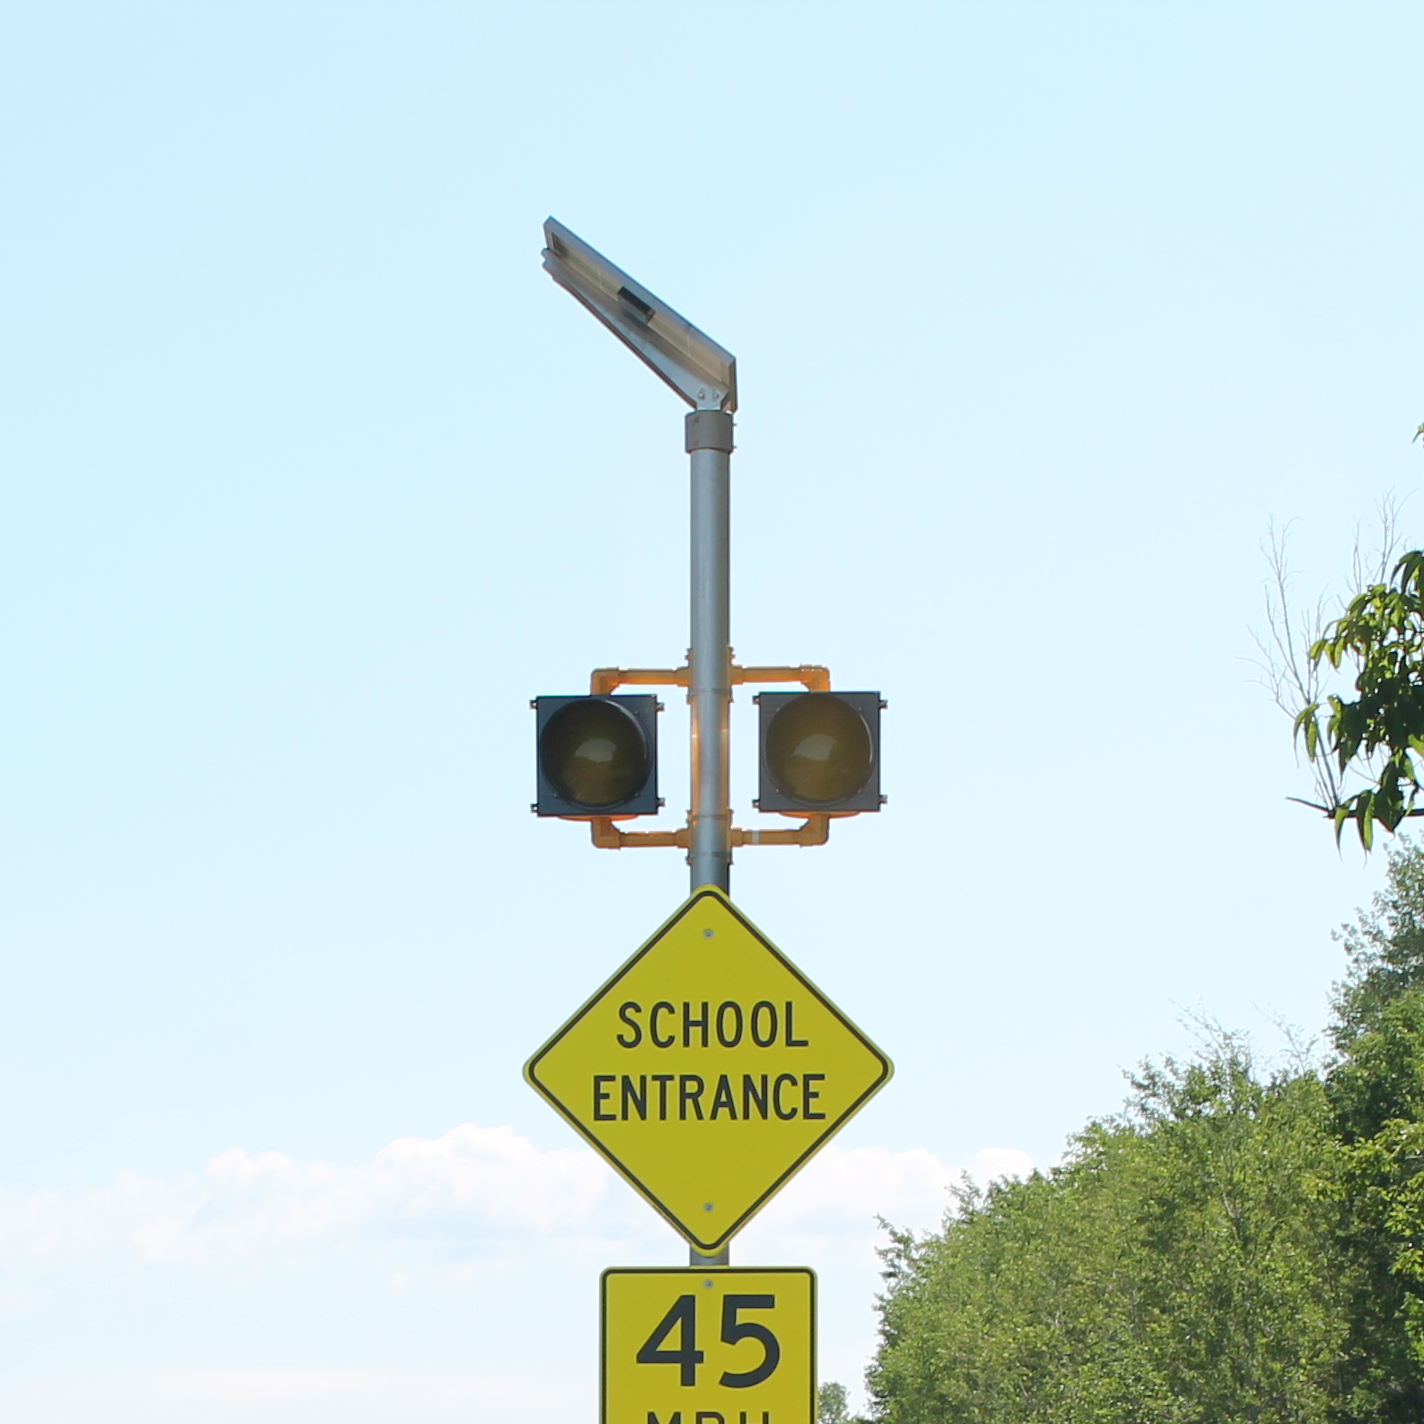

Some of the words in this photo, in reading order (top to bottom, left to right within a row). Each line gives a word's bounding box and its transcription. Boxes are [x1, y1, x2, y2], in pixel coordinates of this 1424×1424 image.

[616, 1001, 809, 1048] SCHOOL
[593, 1074, 826, 1121] ENTRANCE
[636, 1294, 781, 1388] 45
